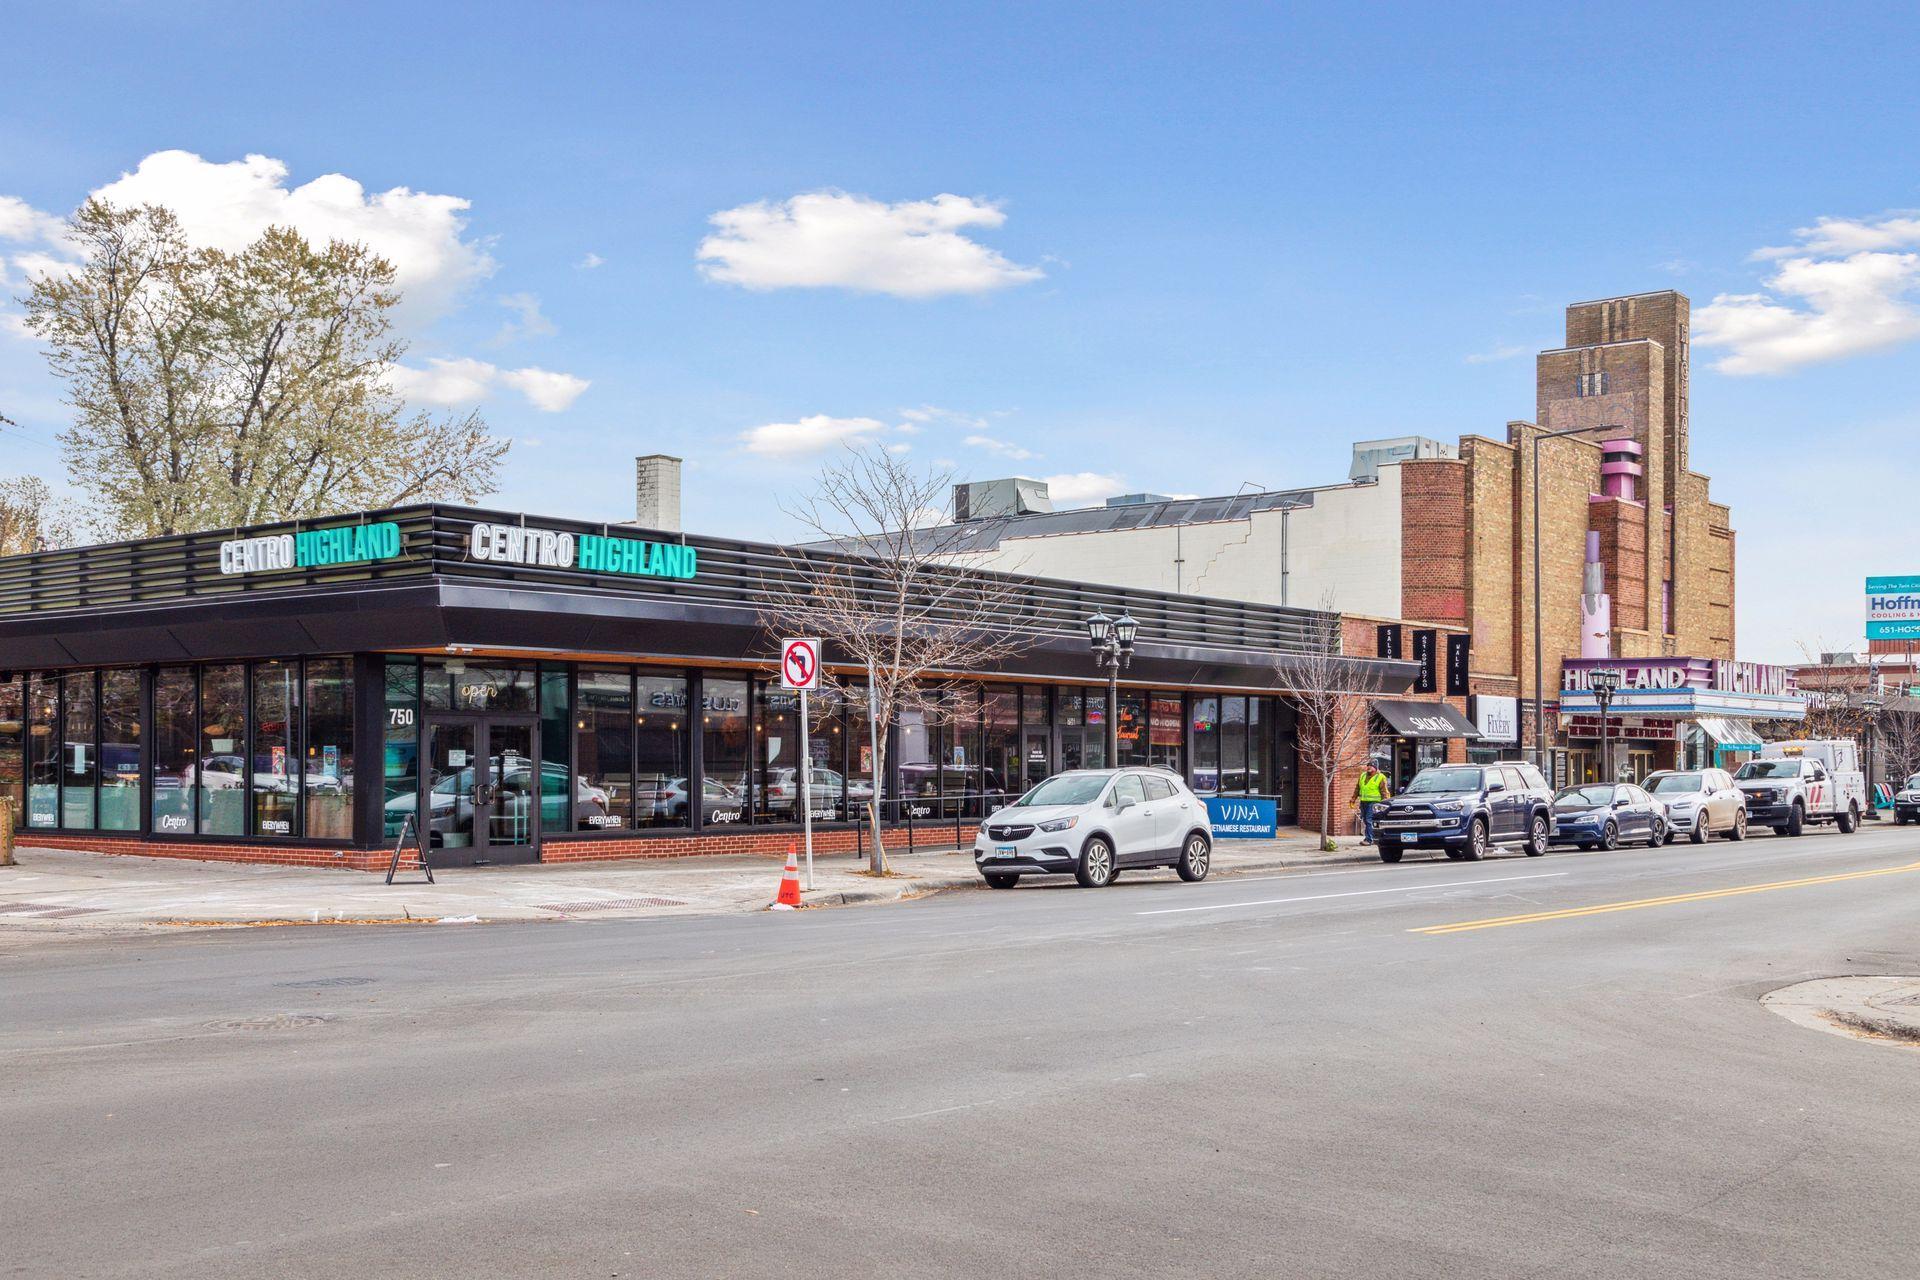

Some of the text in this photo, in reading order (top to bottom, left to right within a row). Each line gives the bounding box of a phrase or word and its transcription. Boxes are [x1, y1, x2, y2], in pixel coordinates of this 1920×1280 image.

[220, 522, 400, 575] CENTRO HIGHLAND
[472, 523, 697, 579] CENTRO HIGHLAND
[1564, 667, 1686, 689] HILAND
[1718, 660, 1786, 696] HIGHLAND
[461, 685, 498, 704] open
[390, 709, 413, 725] 750
[1165, 719, 1180, 727] OPEN
[1487, 714, 1510, 734] FIXERY
[589, 815, 622, 825] EVERYWHEN
[712, 809, 740, 824] Centro
[1221, 805, 1259, 820] VINA
[162, 814, 187, 829] Centro
[262, 820, 289, 829] EVERYWHEN
[1211, 824, 1271, 833] ETNAMESE RESTAURANT
